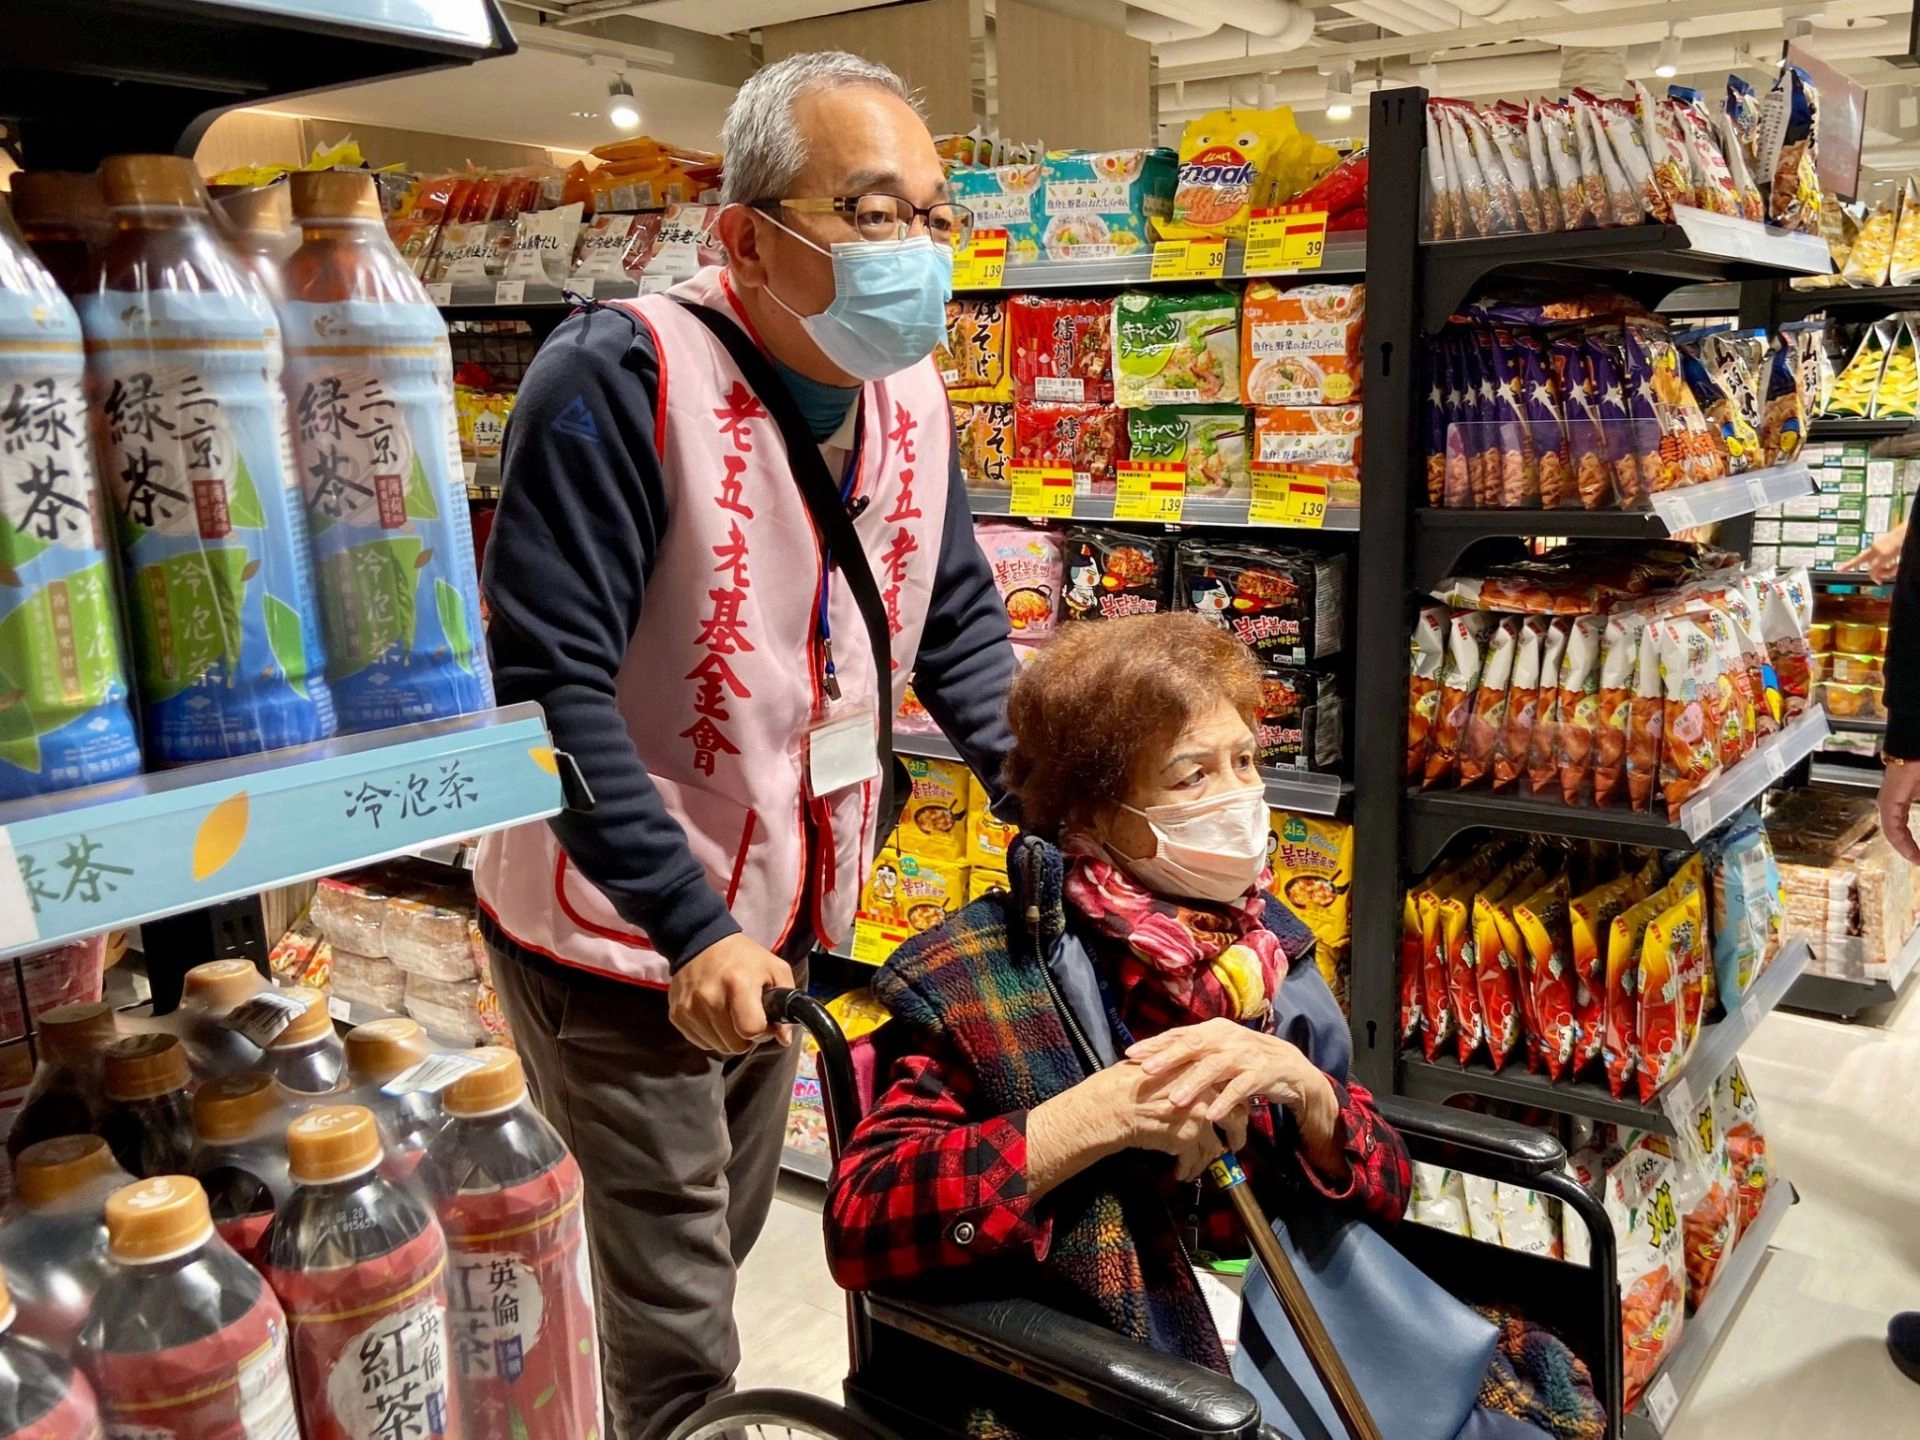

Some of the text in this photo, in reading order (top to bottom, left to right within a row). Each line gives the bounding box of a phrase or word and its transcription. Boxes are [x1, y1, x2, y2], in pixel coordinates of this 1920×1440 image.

[1208, 252, 1224, 268] 39
[1306, 241, 1322, 257] 39
[983, 264, 1002, 279] 139
[1122, 319, 1181, 341] キャベツ
[171, 375, 222, 470] 三京
[355, 378, 398, 465] 三京
[1132, 419, 1190, 441] キャベツ
[103, 372, 190, 528] 綠茶
[296, 377, 374, 518] 綠茶
[1131, 441, 1175, 457] ラーメン
[1052, 494, 1072, 508] 139
[1160, 498, 1181, 513] 139
[1300, 501, 1324, 518] 139
[679, 380, 769, 777] 老五老基金會
[1100, 593, 1157, 621] 불닭볶음면
[1232, 614, 1300, 646] 불닭볶음면
[344, 760, 479, 830] 冷泡茶
[1283, 822, 1307, 837] 치즈
[1280, 843, 1337, 869] 불닭볶음면
[487, 1258, 520, 1327] 英倫
[416, 1308, 443, 1382] 英倫
[358, 1319, 424, 1440] 紅茶
